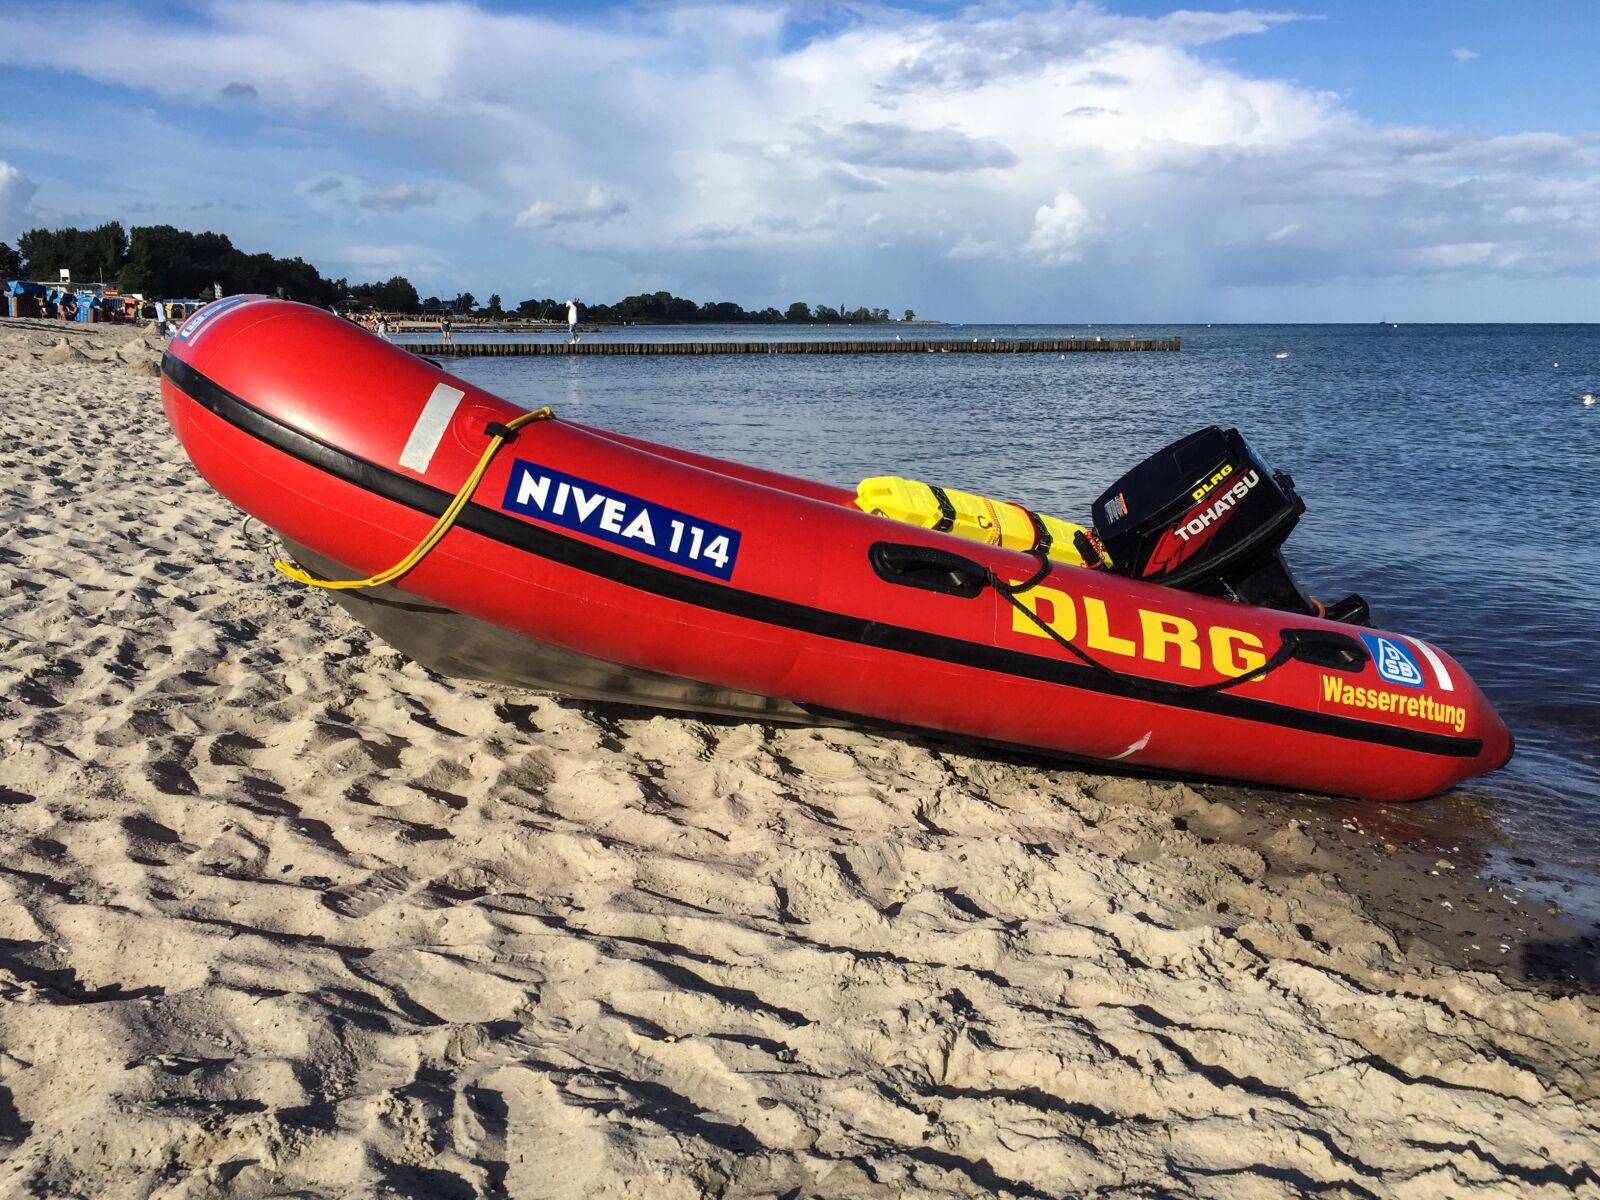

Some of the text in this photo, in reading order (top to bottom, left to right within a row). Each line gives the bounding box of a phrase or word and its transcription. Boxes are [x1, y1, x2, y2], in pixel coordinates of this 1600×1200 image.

[1174, 469, 1260, 541] TOHATSU
[1192, 464, 1233, 501] DLRG
[516, 469, 730, 569] NIVEA 114
[1008, 578, 1267, 683] DLRG
[1322, 675, 1466, 733] Wasserrettung
